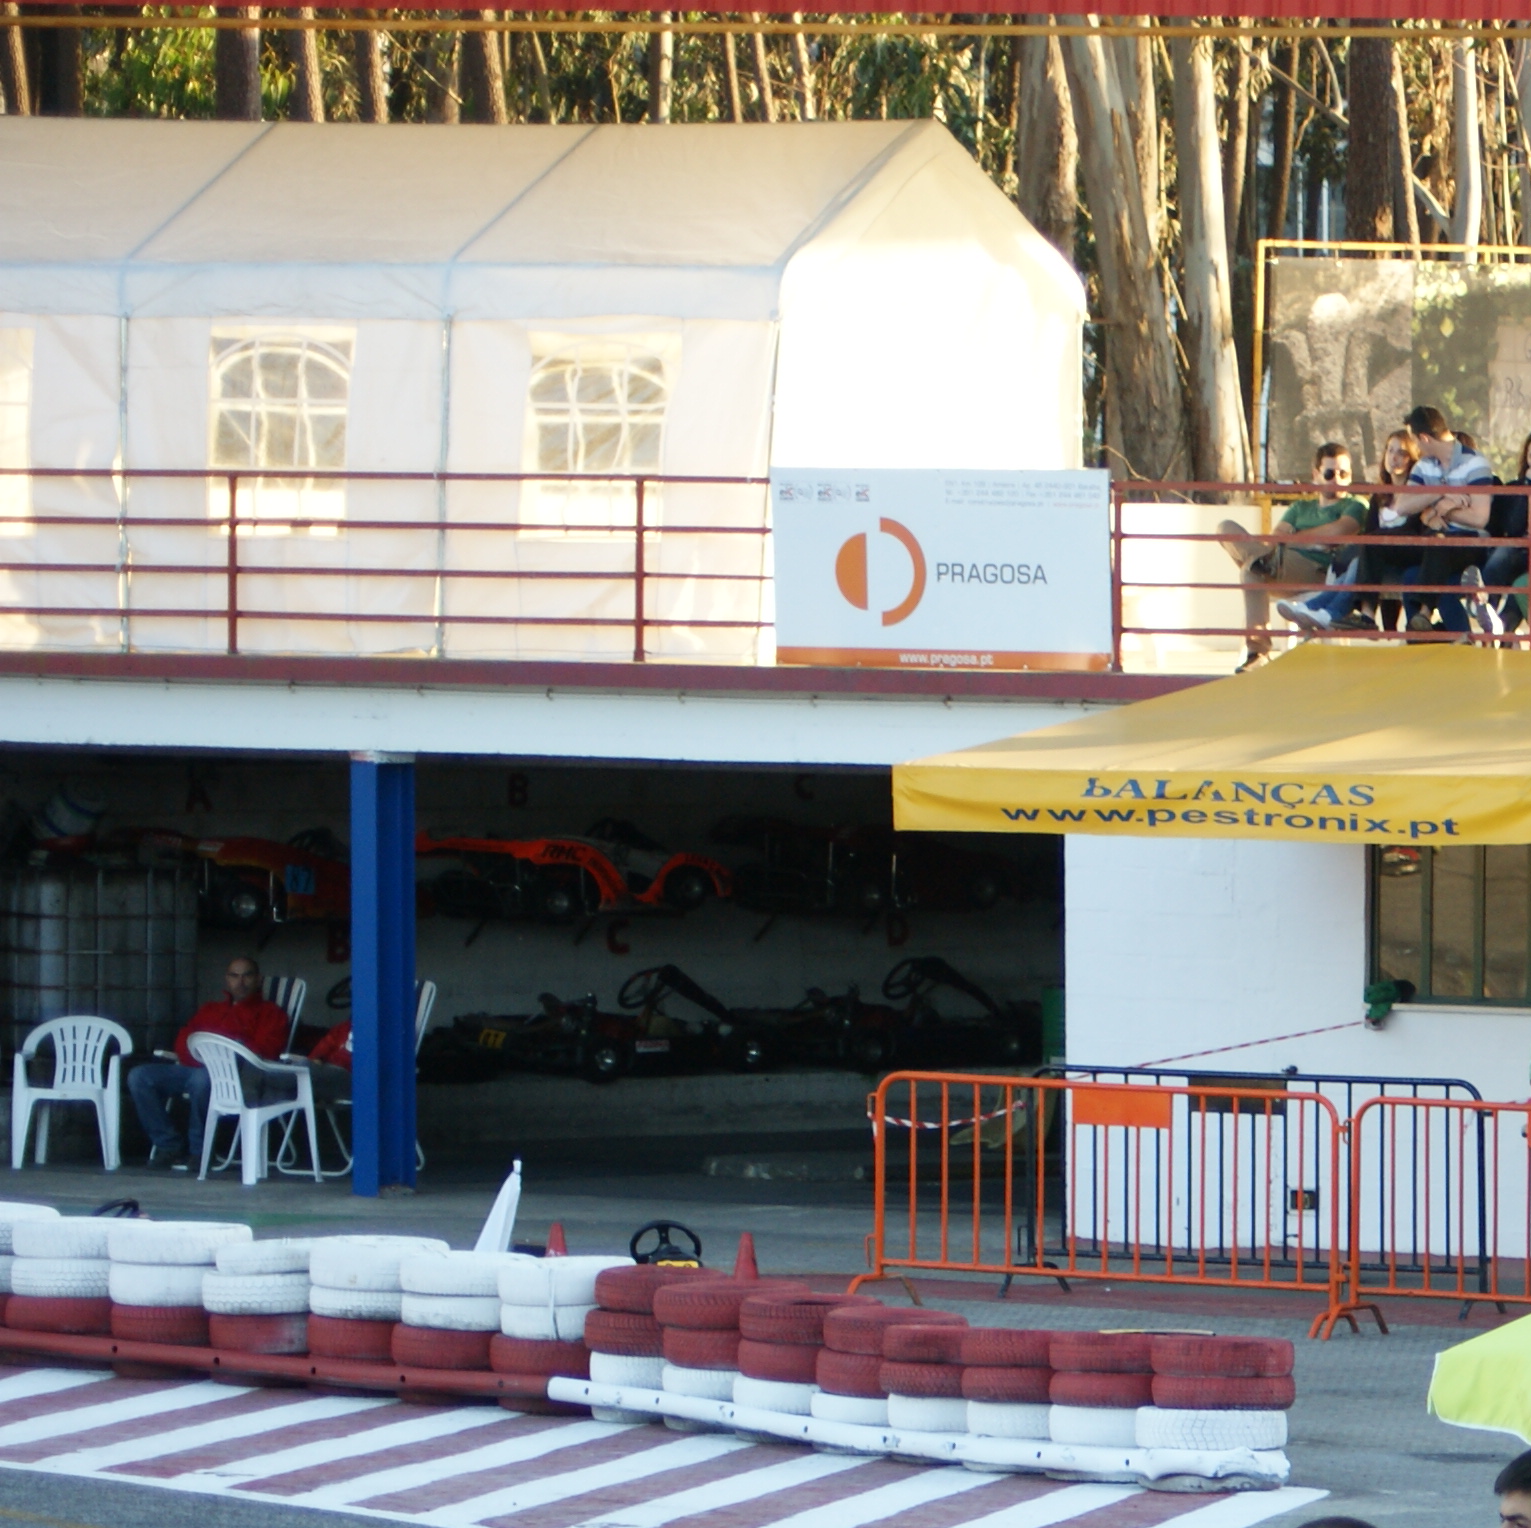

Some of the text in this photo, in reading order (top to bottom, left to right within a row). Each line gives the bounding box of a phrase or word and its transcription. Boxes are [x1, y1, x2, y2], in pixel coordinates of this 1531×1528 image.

[936, 563, 1047, 584] PRAGOSA
[899, 653, 993, 666] www.pragosa.pt
[508, 772, 529, 807] B
[1081, 777, 1375, 809] BALANÇAS
[1001, 807, 1460, 838] www.pestronix.pt
[607, 919, 630, 954] C
